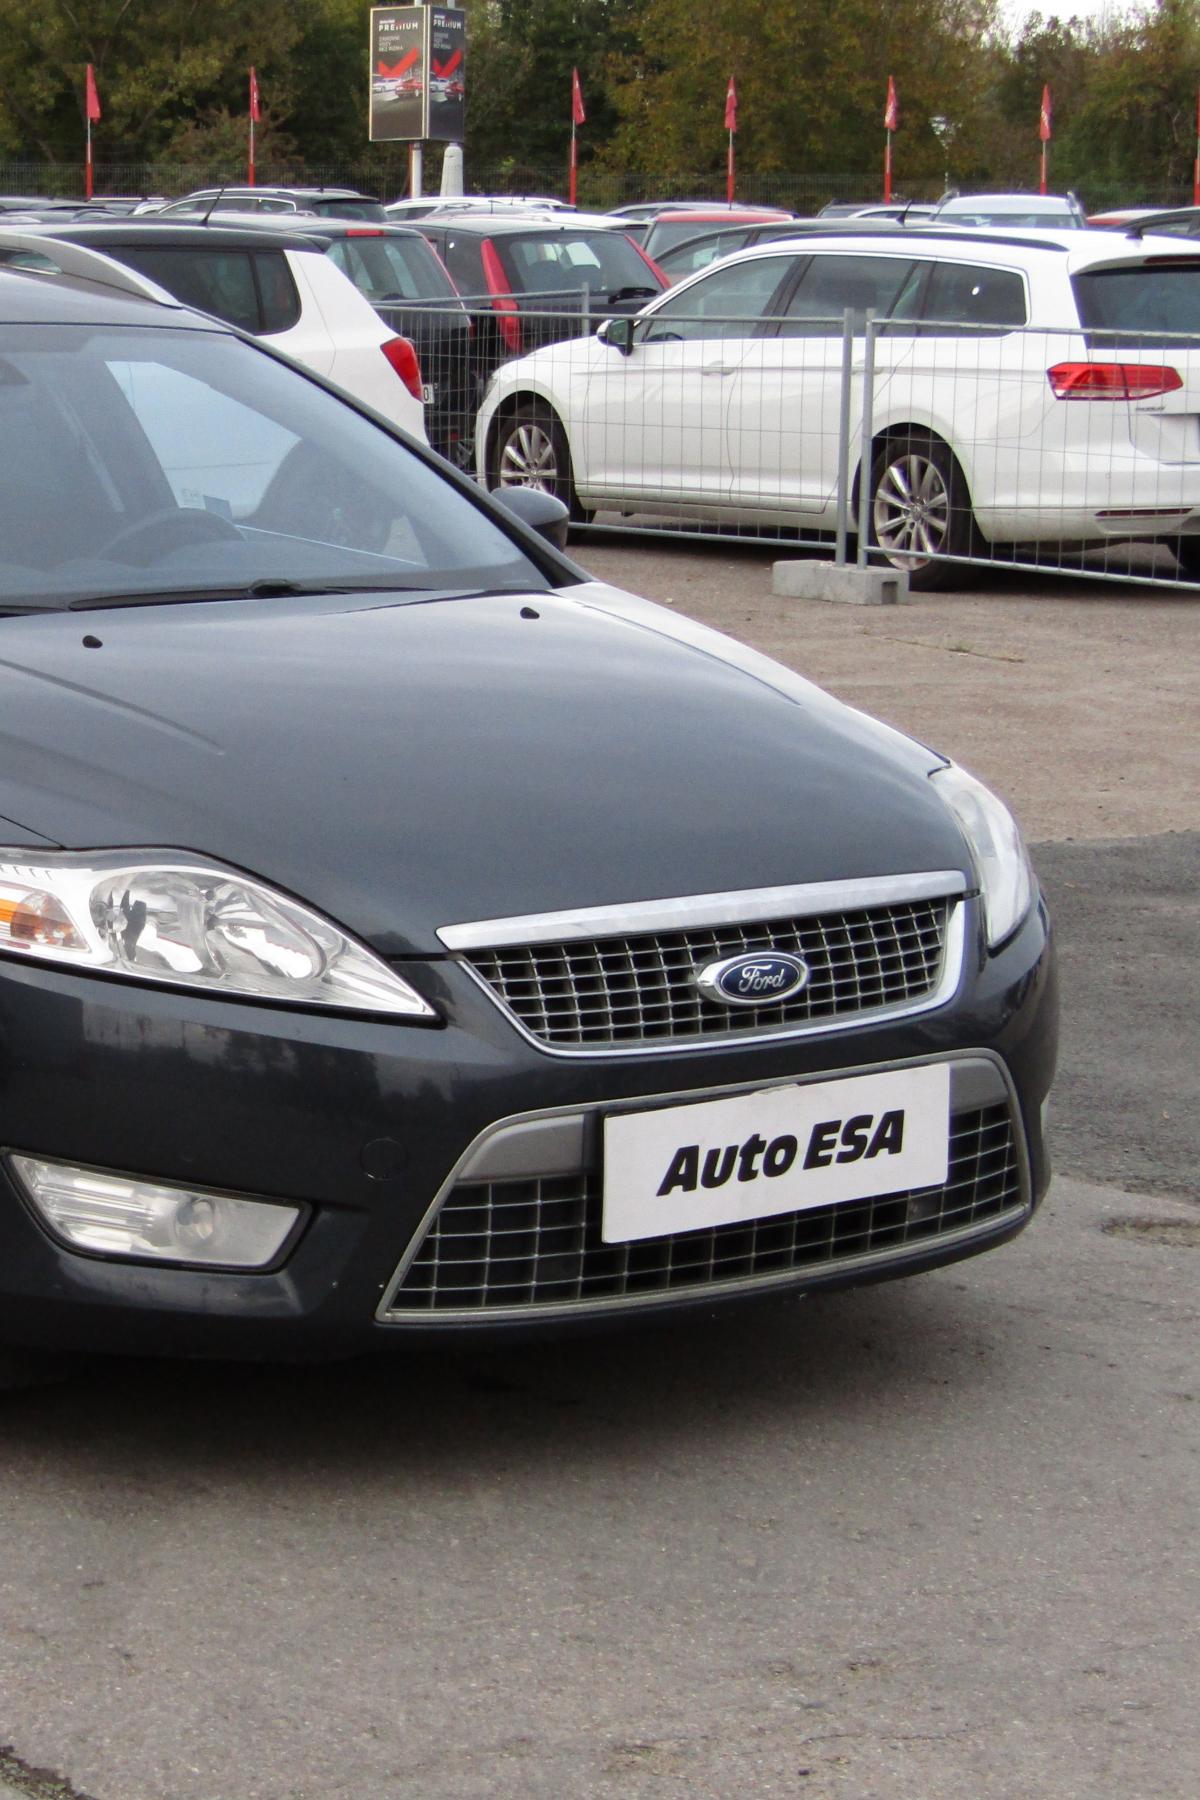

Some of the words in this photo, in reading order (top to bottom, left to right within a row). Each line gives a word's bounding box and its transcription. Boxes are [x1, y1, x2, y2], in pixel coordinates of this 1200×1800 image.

[378, 22, 418, 32] PREMIUM
[433, 18, 462, 30] PREMIUM
[738, 964, 786, 992] Ford
[656, 1133, 798, 1197] Auto
[803, 1109, 905, 1170] ESA
